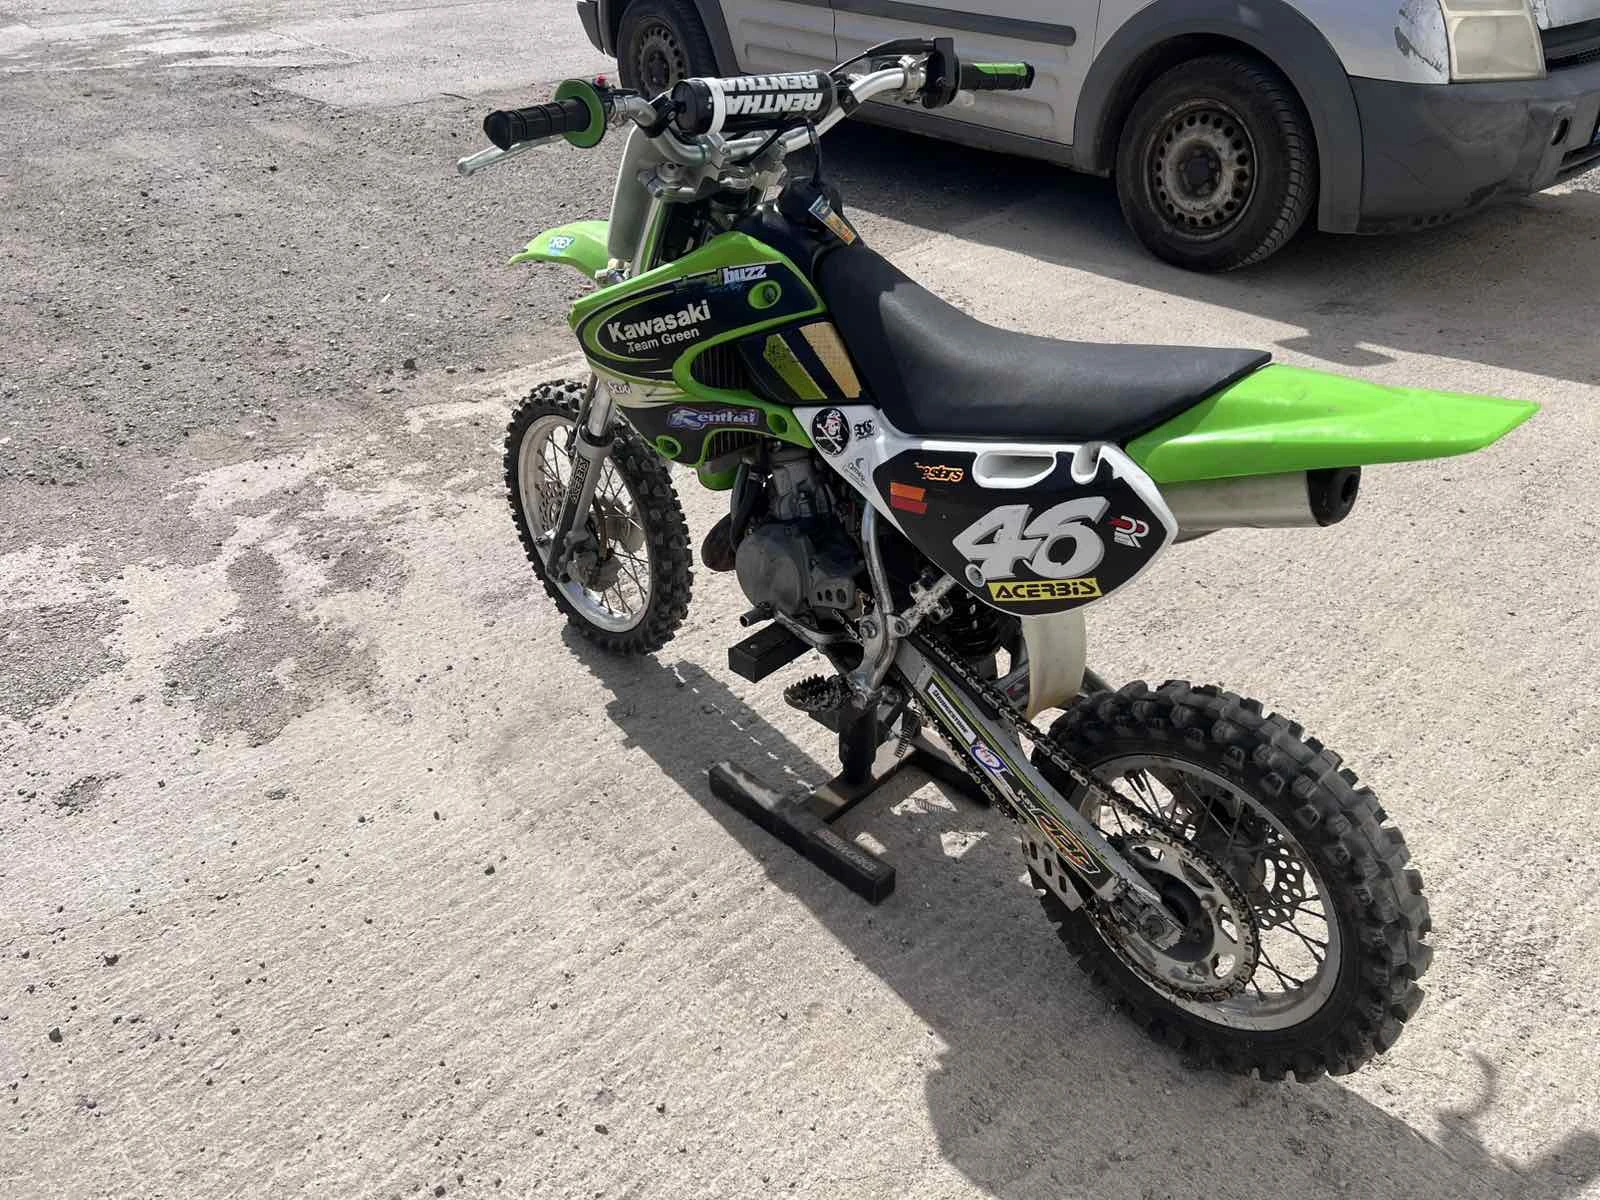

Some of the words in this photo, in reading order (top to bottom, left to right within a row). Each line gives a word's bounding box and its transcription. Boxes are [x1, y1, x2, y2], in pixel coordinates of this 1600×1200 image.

[720, 75, 818, 91] RENTHA
[726, 93, 823, 114] RENTHA
[607, 300, 712, 343] Kawasaki
[627, 338, 659, 355] Team
[660, 328, 700, 346] Green
[667, 406, 759, 430] Renthal
[953, 496, 1110, 580] 46
